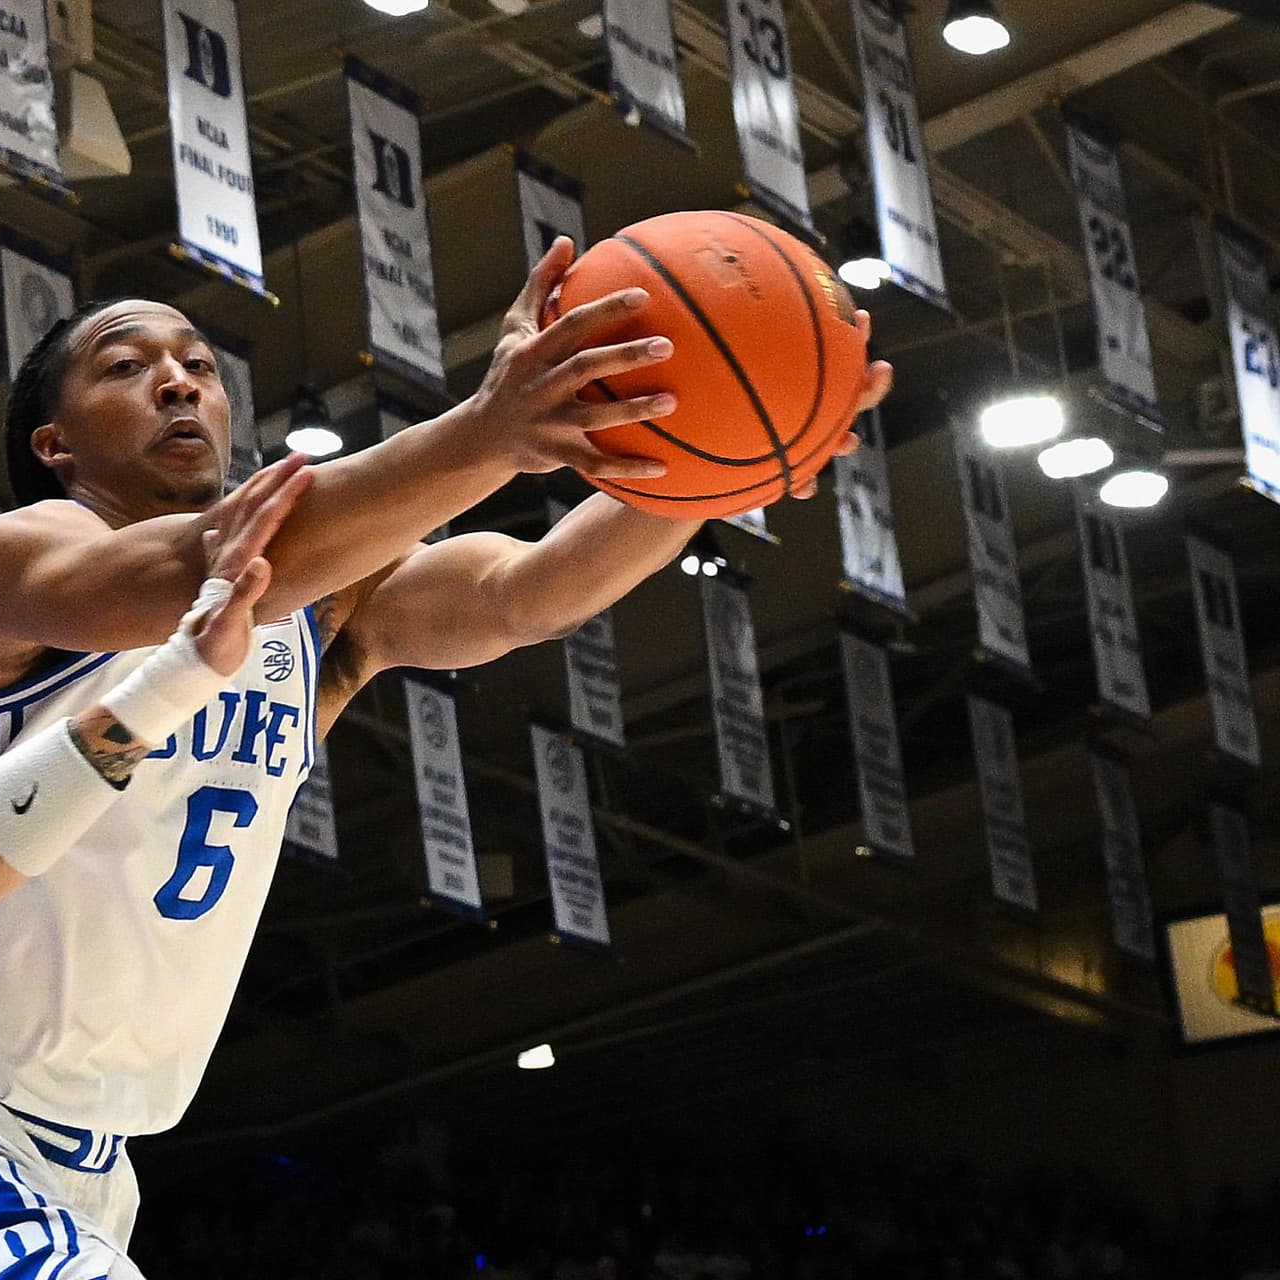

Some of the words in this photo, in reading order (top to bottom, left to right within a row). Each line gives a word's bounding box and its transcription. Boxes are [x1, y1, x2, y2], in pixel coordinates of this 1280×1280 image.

[179, 142, 216, 181] FINAL
[196, 115, 230, 150] NCAA
[145, 689, 300, 778] UKE
[153, 785, 259, 920] 6
